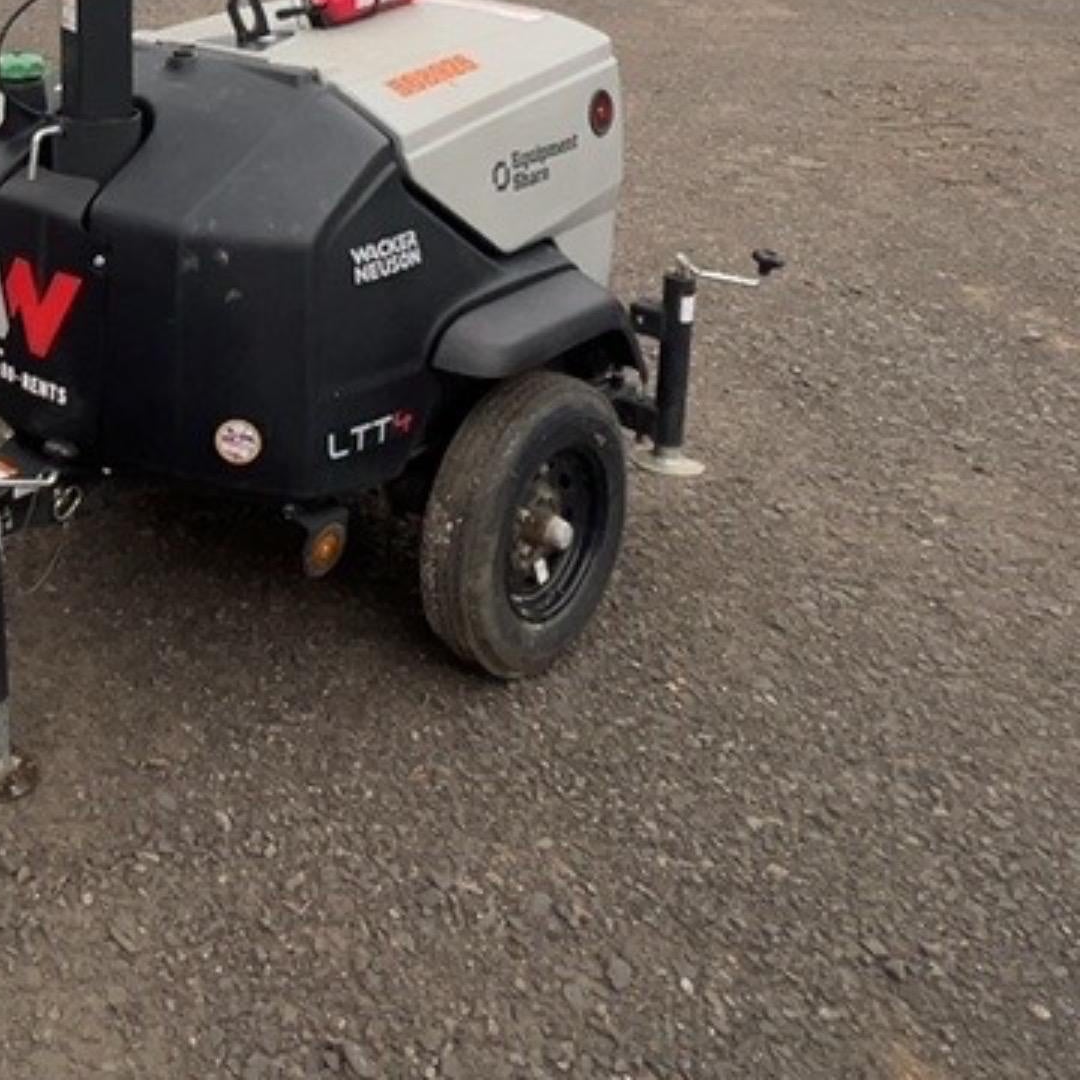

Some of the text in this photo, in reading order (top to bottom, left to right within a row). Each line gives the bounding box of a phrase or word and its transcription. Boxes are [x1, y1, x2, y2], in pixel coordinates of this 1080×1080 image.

[511, 134, 578, 169] Equipment
[512, 167, 550, 192] Share
[350, 230, 418, 265] WACKER
[352, 250, 422, 285] NEUSON
